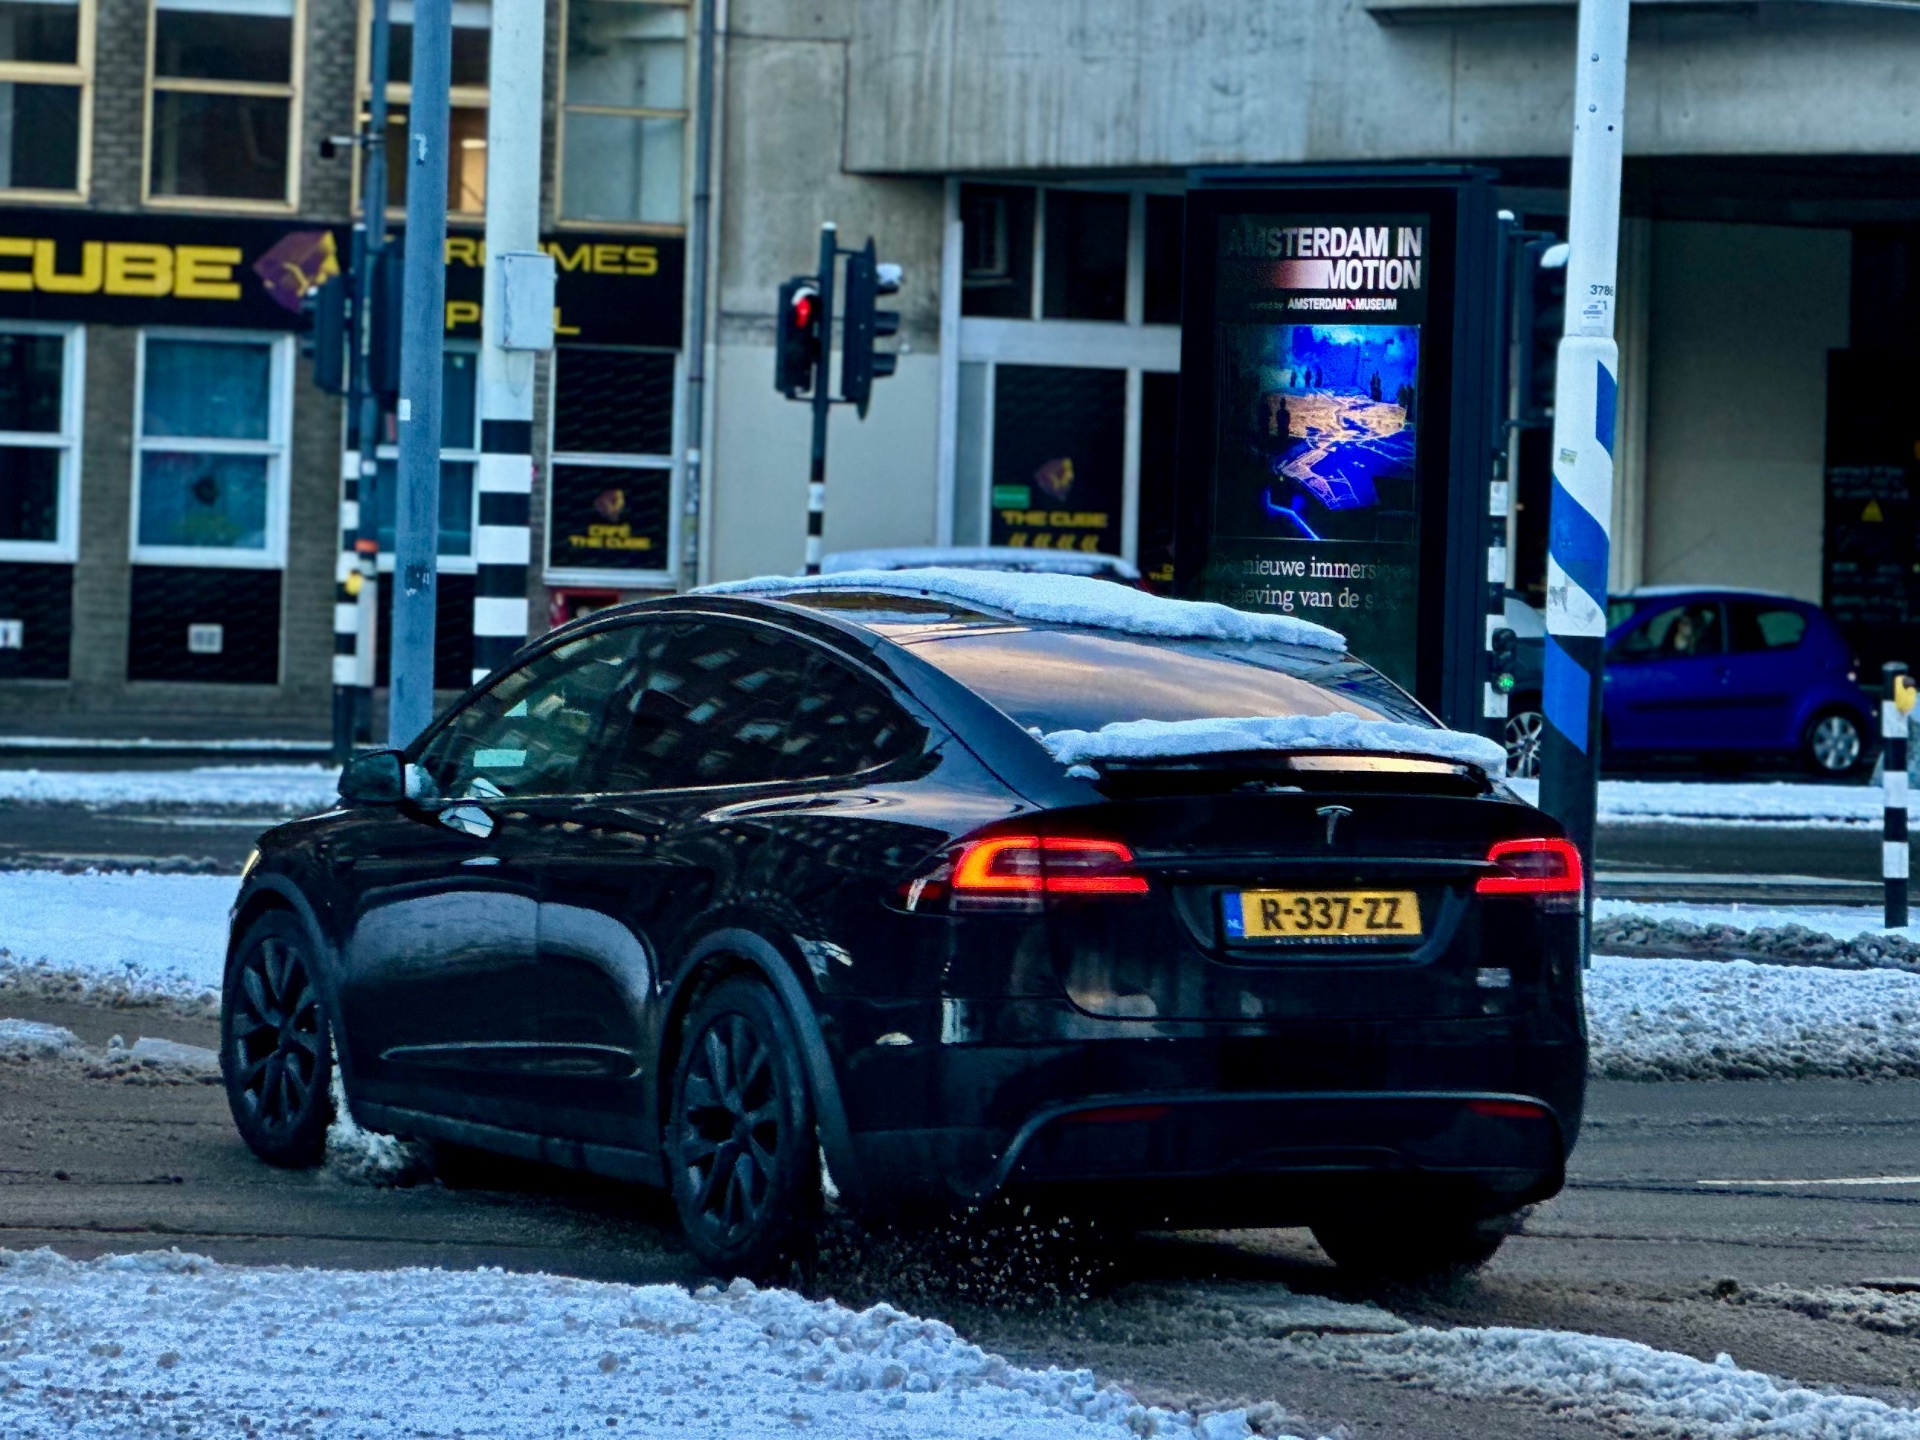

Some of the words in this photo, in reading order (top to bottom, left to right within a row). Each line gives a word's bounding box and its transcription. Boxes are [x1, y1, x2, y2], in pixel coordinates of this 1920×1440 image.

[1398, 226, 1422, 257] IN
[1327, 260, 1422, 290] MOTION
[1002, 511, 1047, 526] THE
[1243, 554, 1305, 577] nieuwe
[1299, 591, 1334, 608] van
[1338, 587, 1360, 609] de
[1260, 896, 1405, 931] R-337-ZZ
